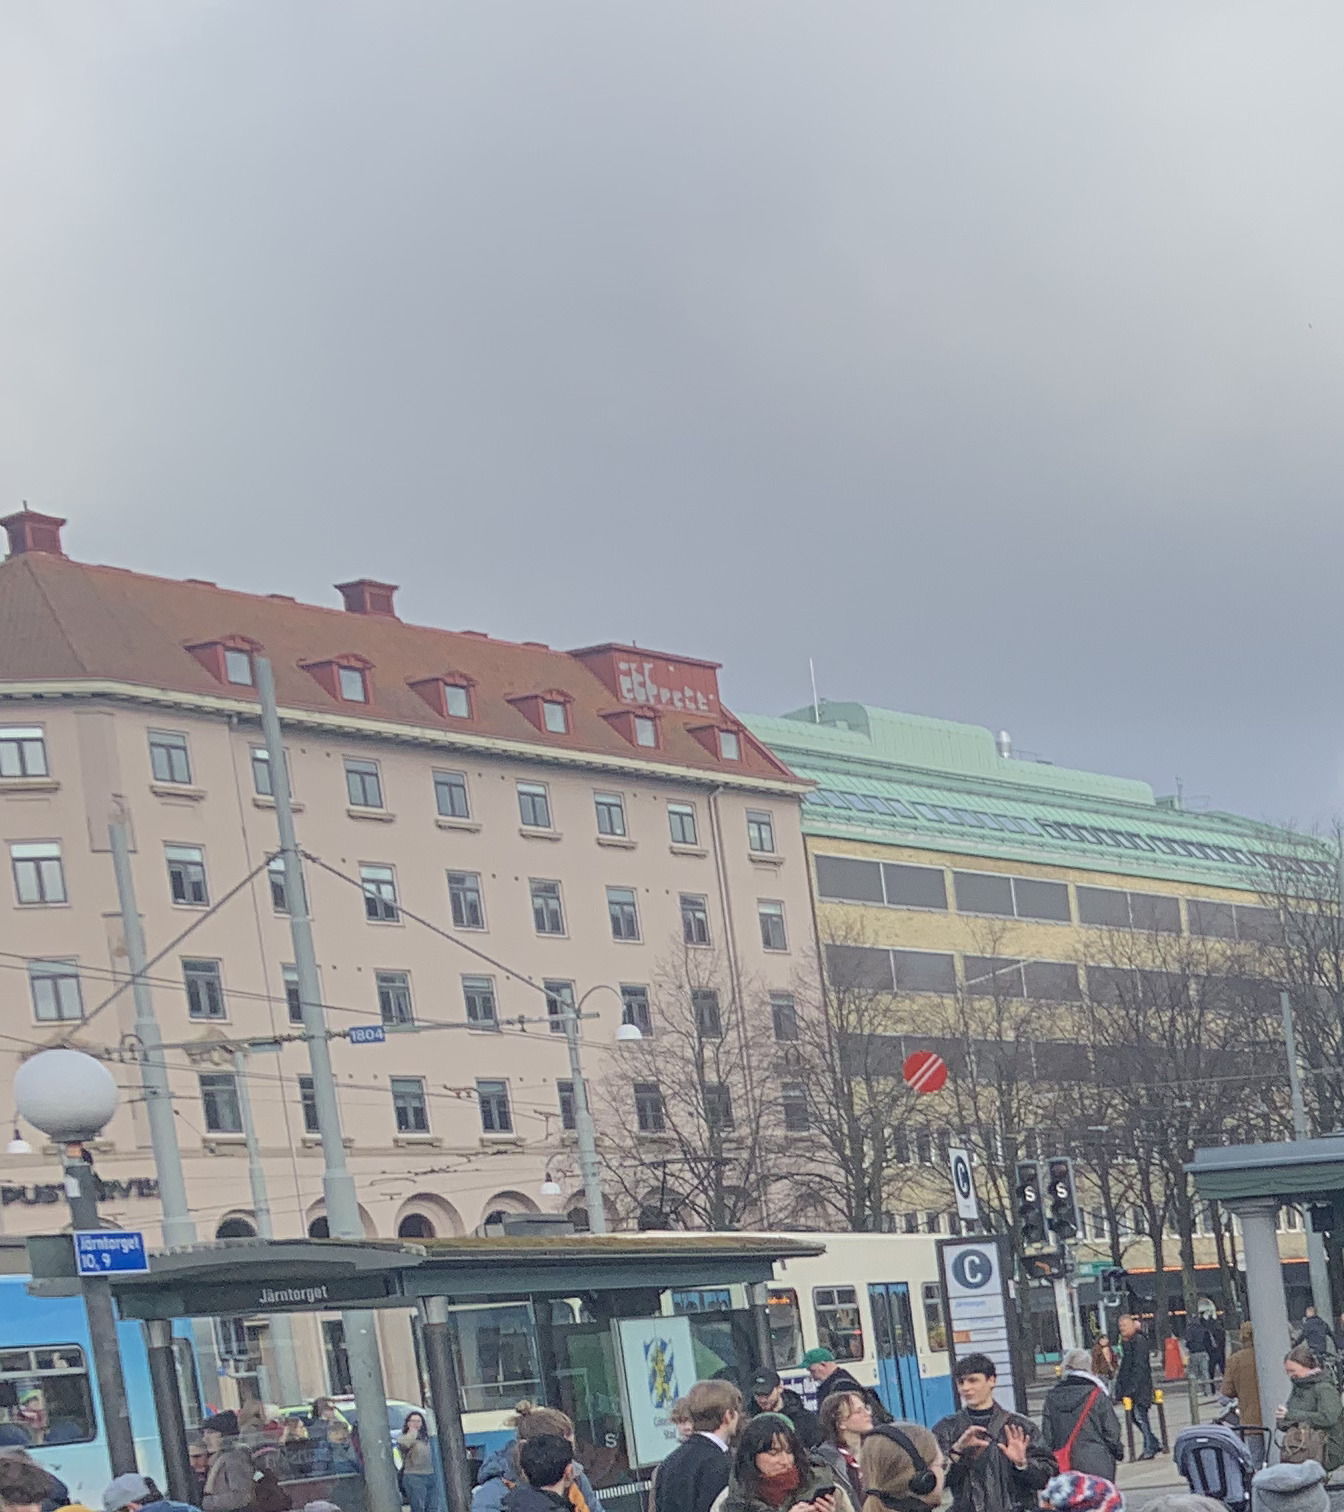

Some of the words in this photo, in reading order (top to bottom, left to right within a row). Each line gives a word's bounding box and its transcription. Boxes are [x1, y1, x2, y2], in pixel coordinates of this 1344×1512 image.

[80, 1235, 140, 1254] Järntorget
[102, 1253, 112, 1268] 9
[963, 1255, 982, 1284] C
[260, 1284, 328, 1304] Järntorget
